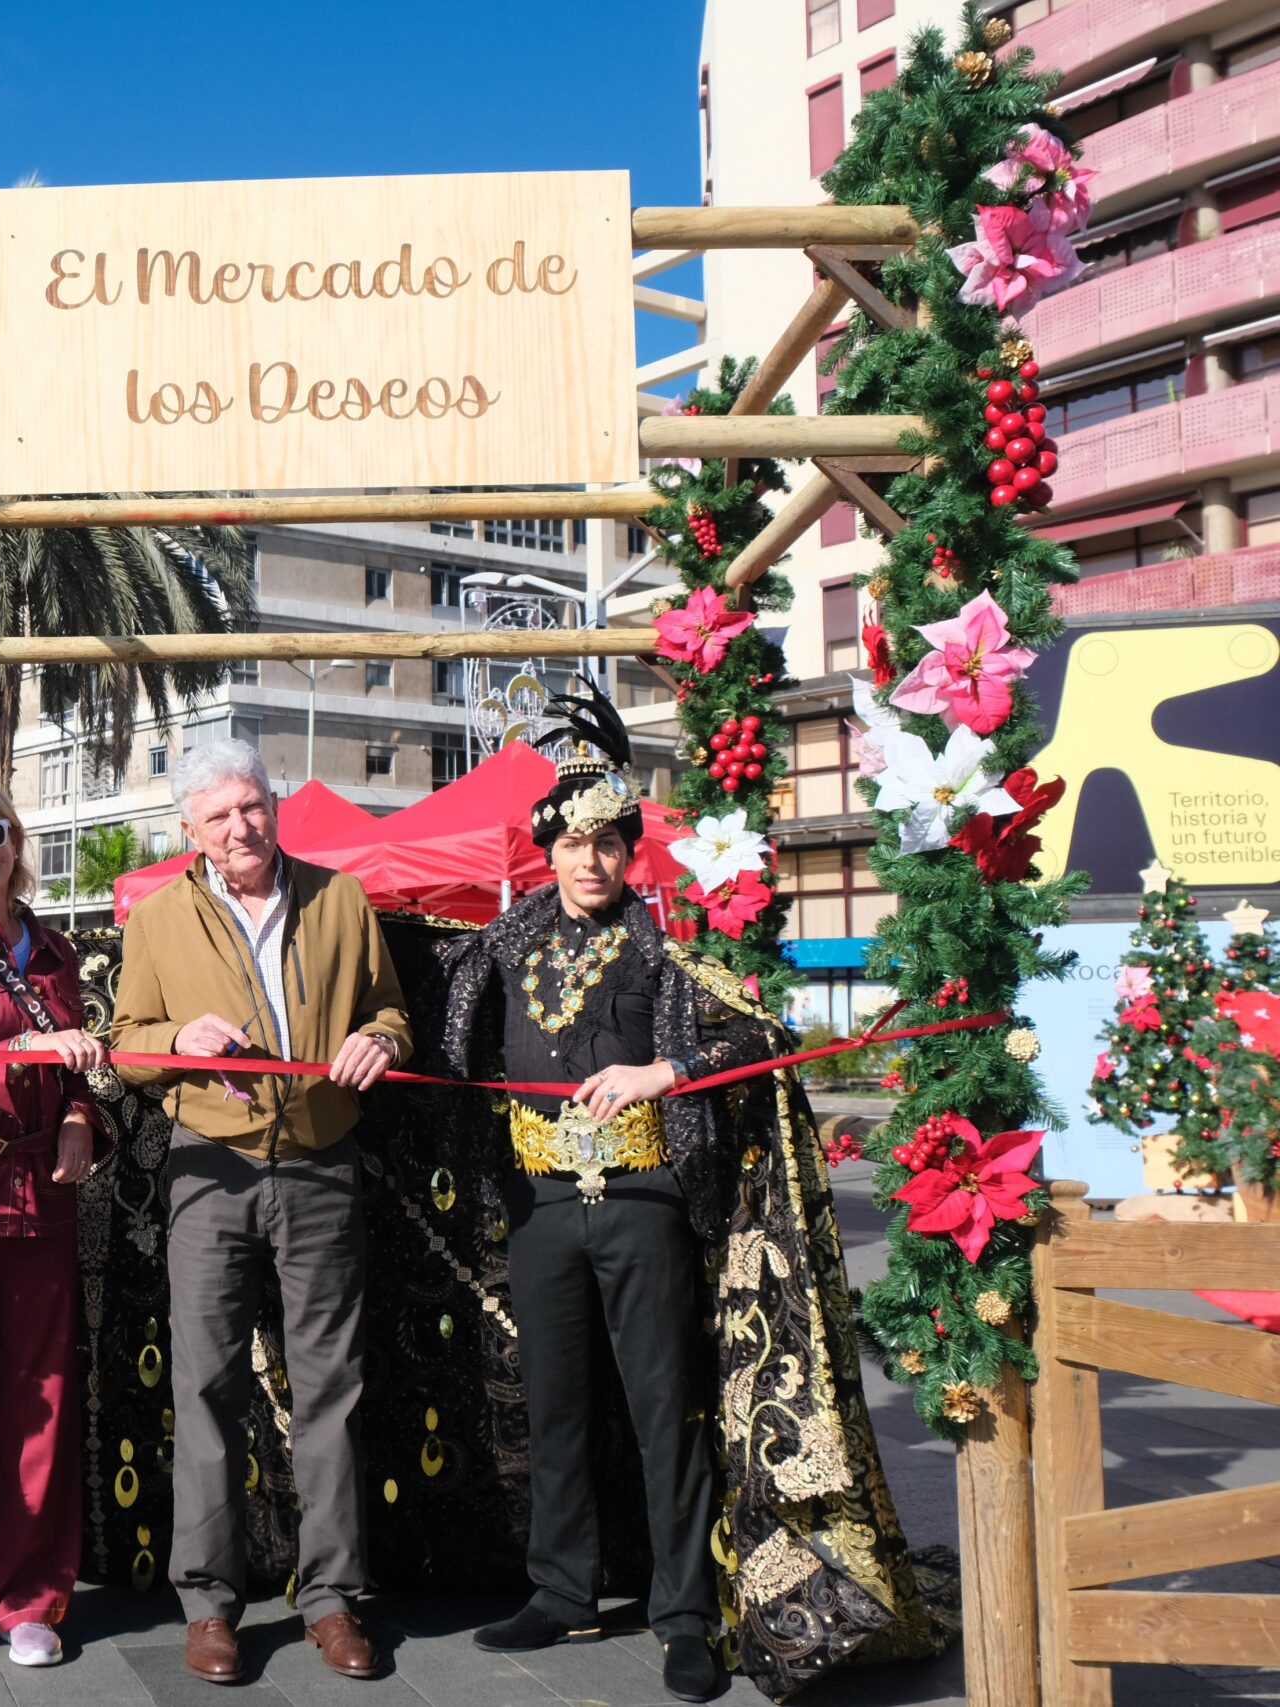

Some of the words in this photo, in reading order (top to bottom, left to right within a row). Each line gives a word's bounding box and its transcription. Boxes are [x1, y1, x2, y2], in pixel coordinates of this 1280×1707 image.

[45, 248, 123, 311] El
[136, 243, 472, 305] Mercado
[485, 240, 579, 297] de
[249, 360, 501, 425] Deseos
[1168, 790, 1269, 808] Territorio,
[1170, 809, 1248, 827] historia
[1254, 811, 1267, 828] y
[1172, 833, 1196, 846] un
[1203, 829, 1267, 845] futuro
[1172, 847, 1280, 864] sostenible
